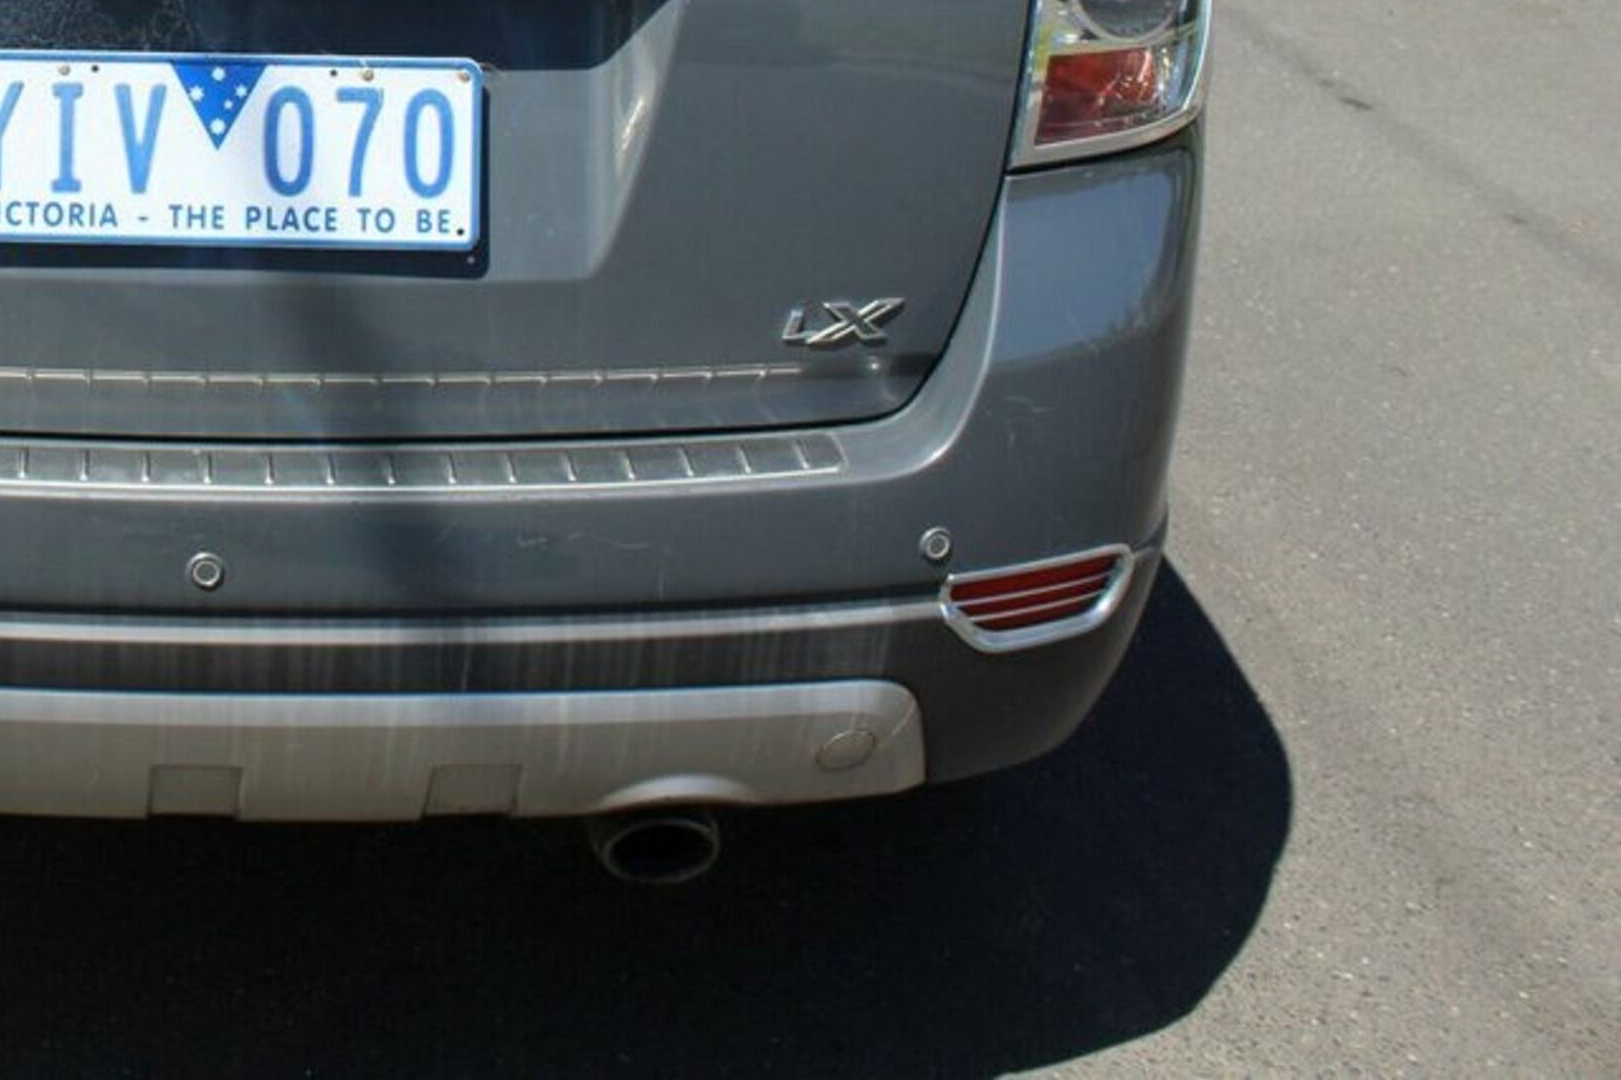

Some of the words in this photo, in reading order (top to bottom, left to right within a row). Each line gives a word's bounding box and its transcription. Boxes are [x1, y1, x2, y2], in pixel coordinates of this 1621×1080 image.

[263, 85, 455, 199] 070
[168, 204, 226, 229] THE
[245, 206, 338, 232] PLACE
[357, 208, 396, 233] TO
[782, 297, 905, 345] LX
